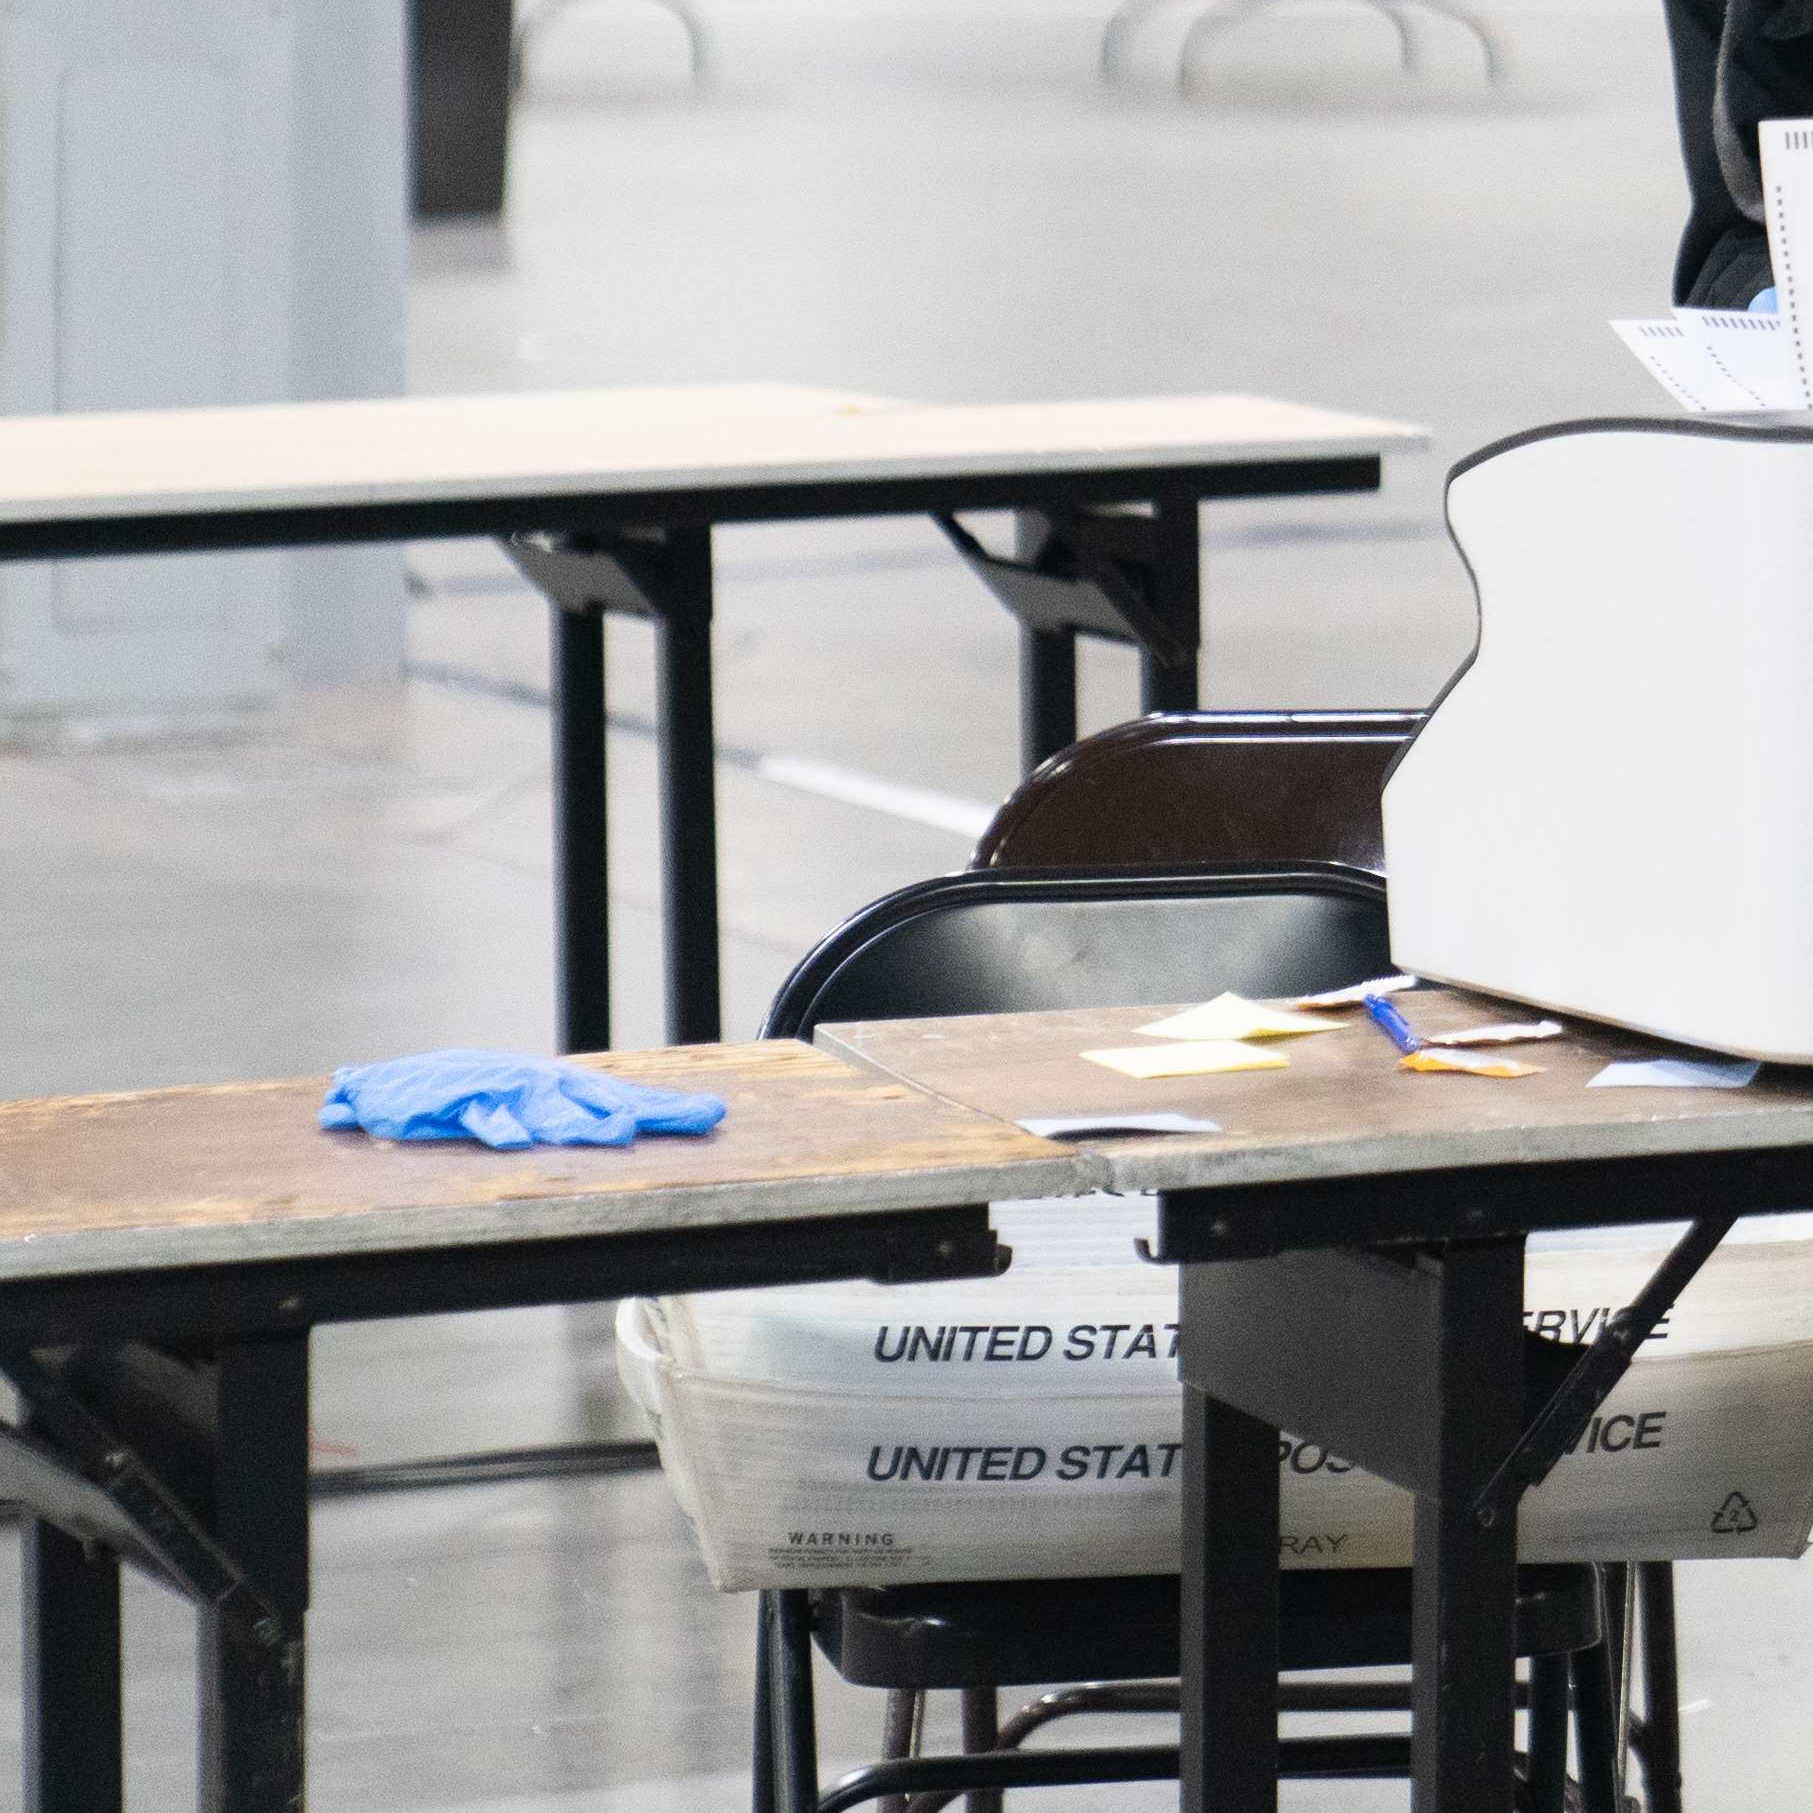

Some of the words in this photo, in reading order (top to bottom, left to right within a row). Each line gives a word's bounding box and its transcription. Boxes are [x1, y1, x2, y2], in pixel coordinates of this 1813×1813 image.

[873, 1325, 1053, 1363] UNITED
[1063, 1323, 1179, 1361] STAT
[867, 1445, 1047, 1481] UNITED
[1055, 1443, 1182, 1481] STAT
[788, 1531, 896, 1547] WARNING
[1280, 1533, 1348, 1555] RAY
